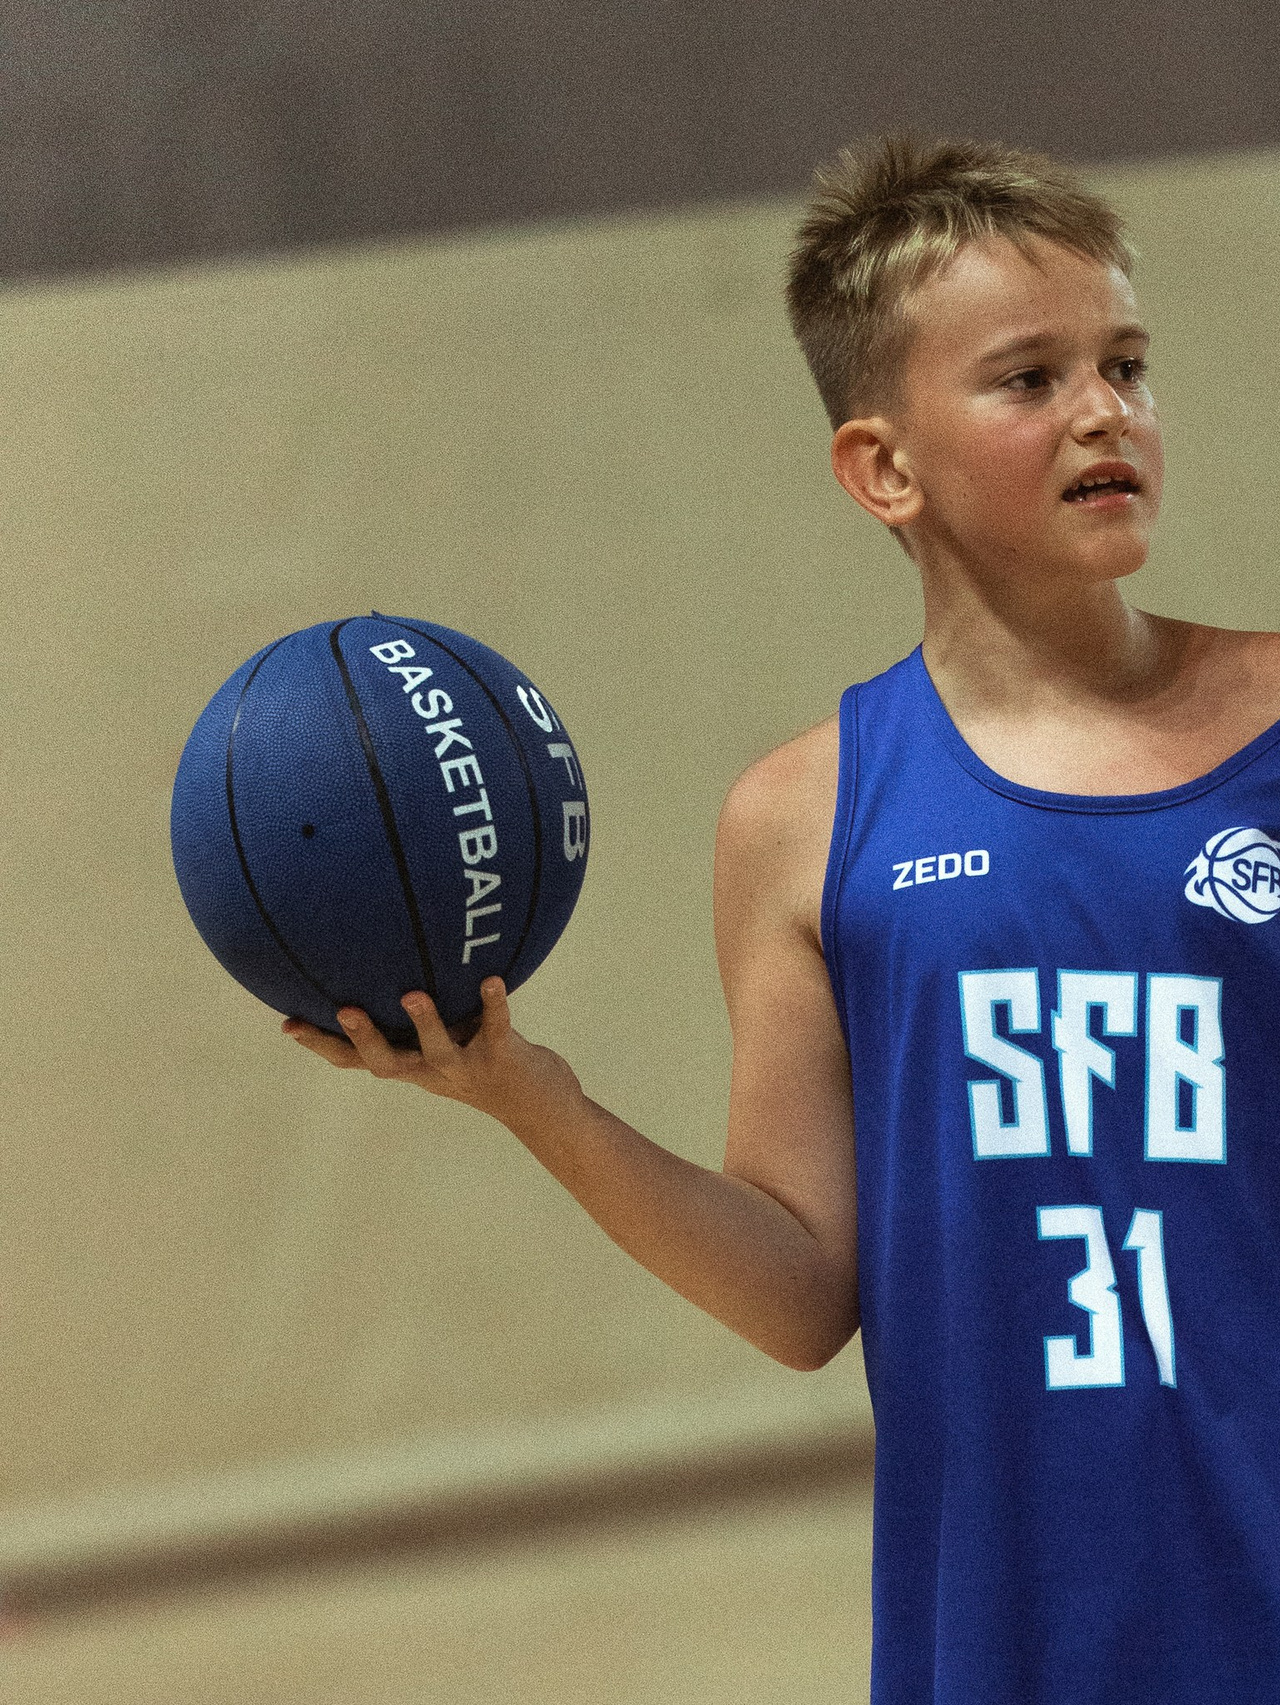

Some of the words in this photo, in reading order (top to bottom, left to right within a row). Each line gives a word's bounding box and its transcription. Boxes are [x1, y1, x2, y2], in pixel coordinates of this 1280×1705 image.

[369, 639, 502, 965] BASKETBALL
[515, 684, 587, 862] SFB
[892, 849, 990, 891] ZEDO
[957, 967, 1228, 1165] SFB
[1036, 1204, 1178, 1391] 31
